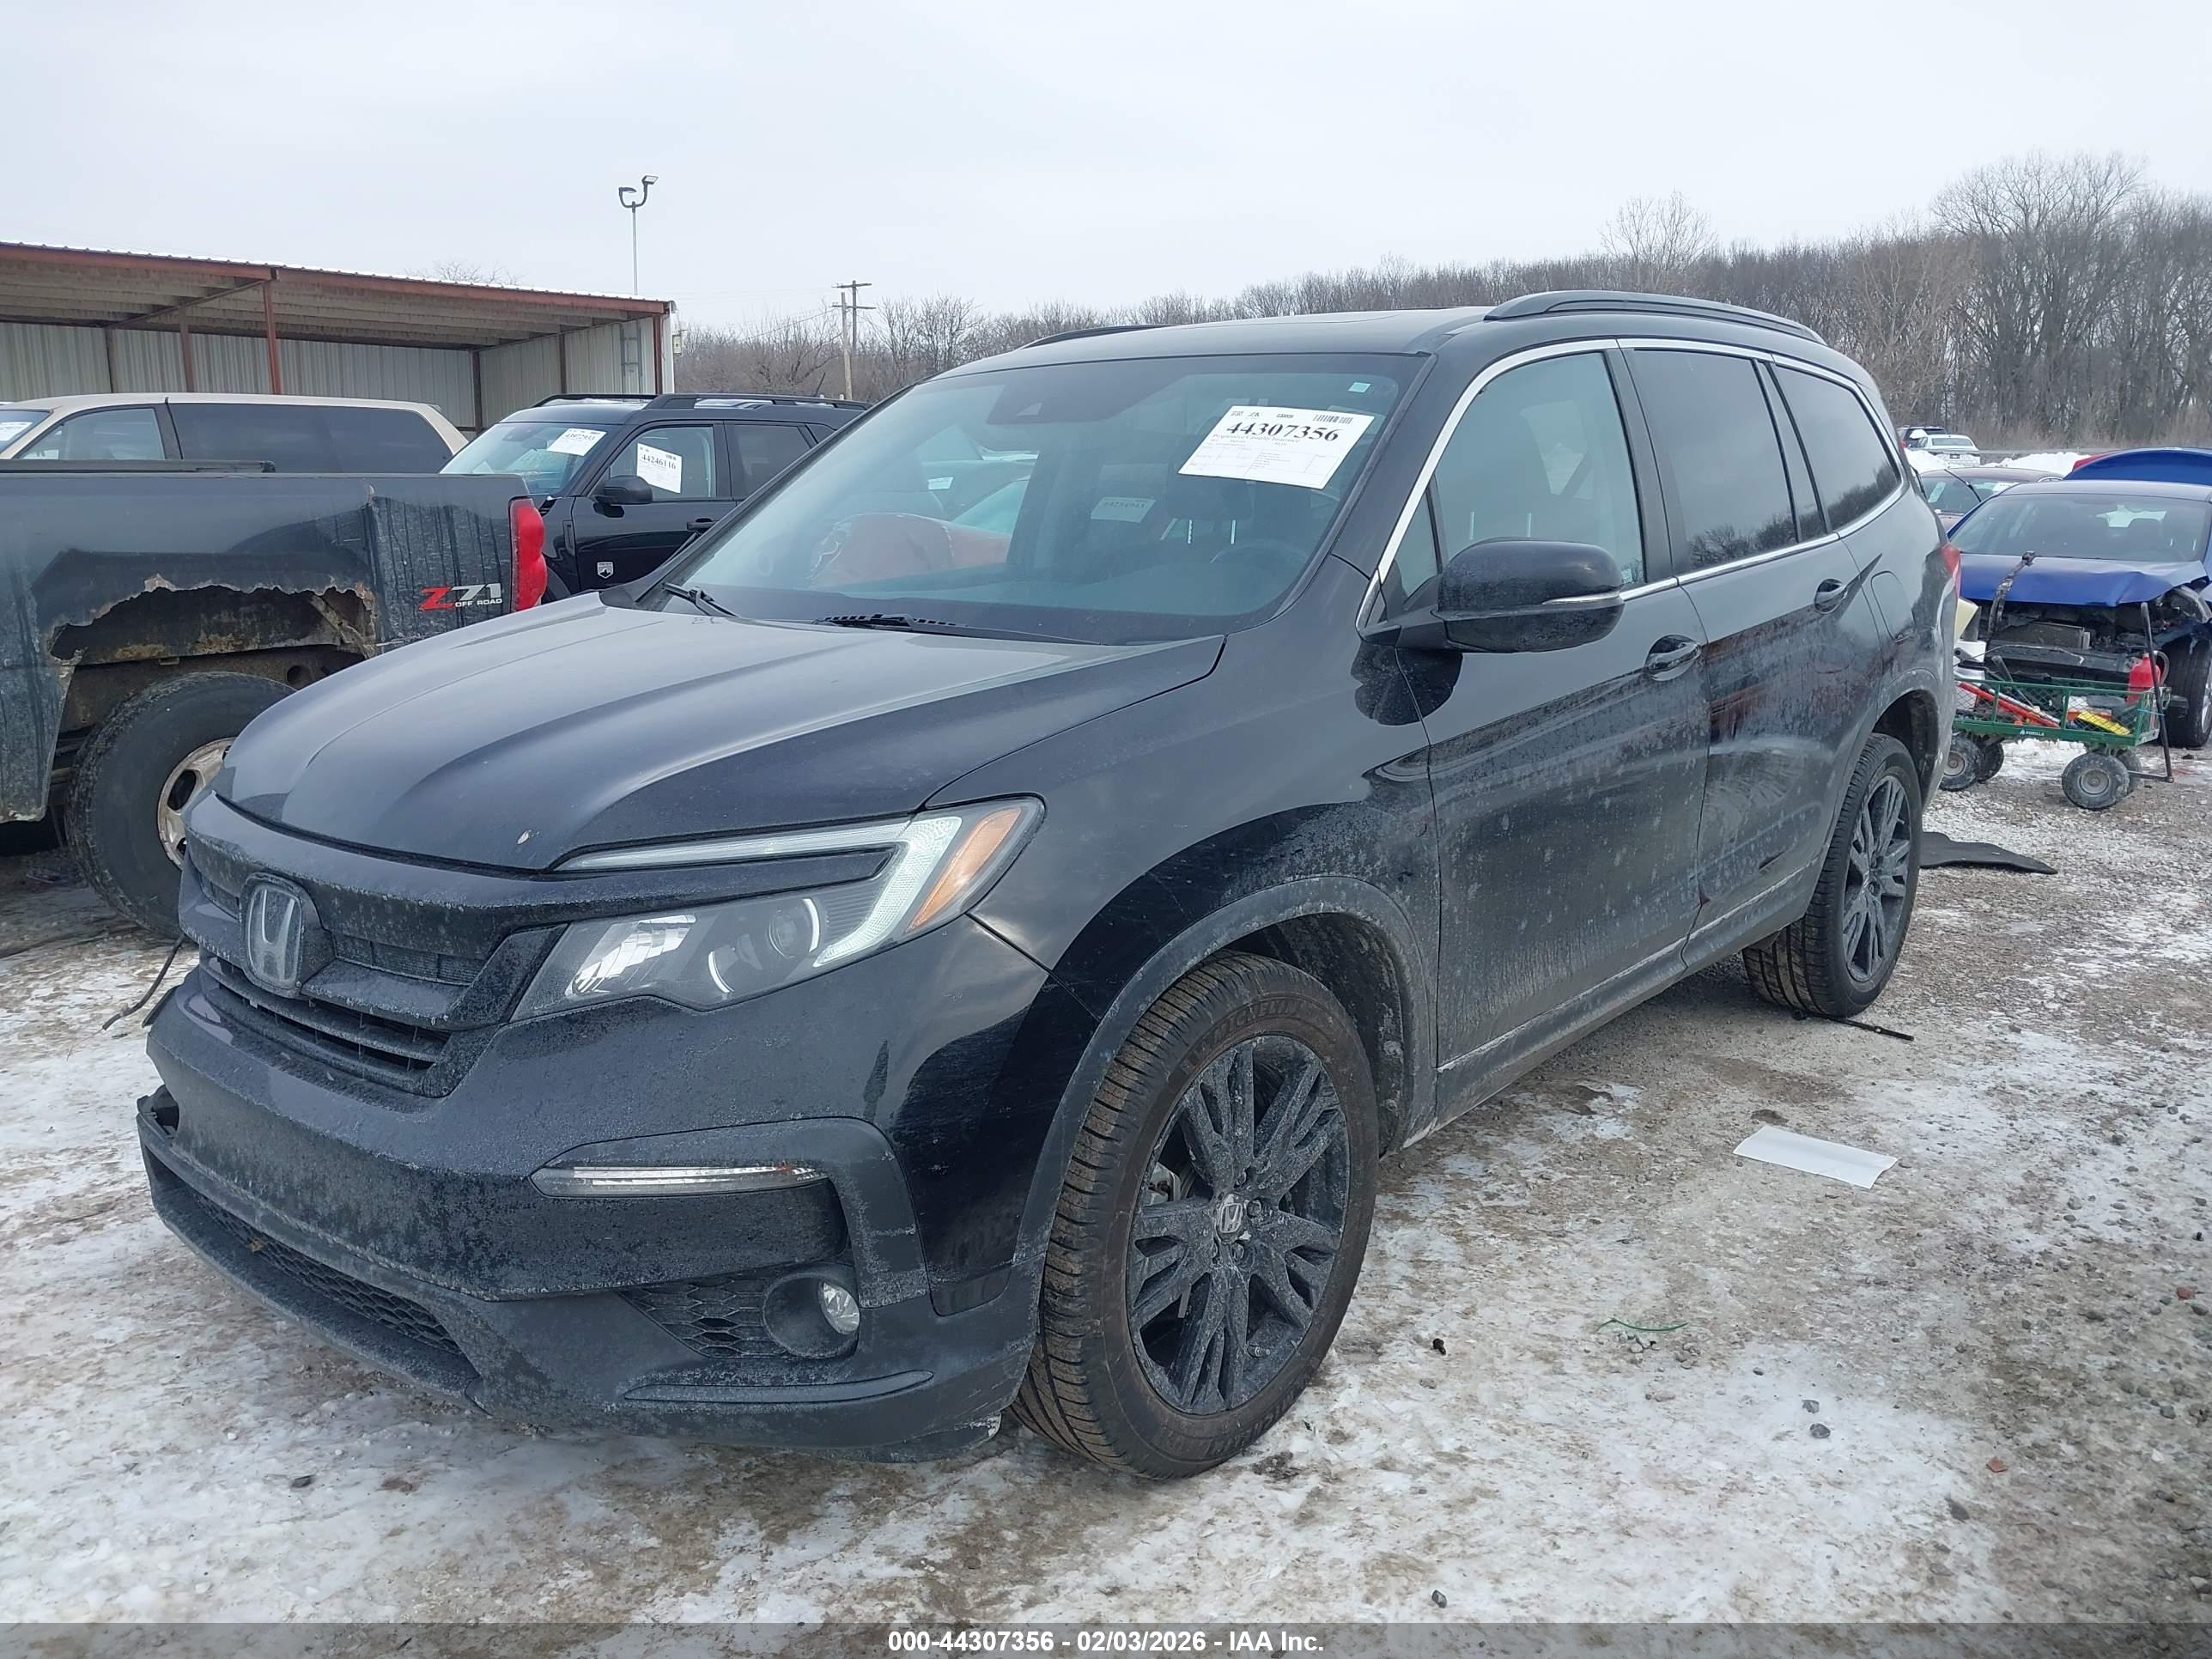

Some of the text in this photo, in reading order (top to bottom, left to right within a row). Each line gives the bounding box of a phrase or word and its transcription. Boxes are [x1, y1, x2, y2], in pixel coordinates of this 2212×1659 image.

[1226, 421, 1346, 442] 44307356
[641, 453, 677, 470] 44246116
[418, 583, 501, 611] Z71
